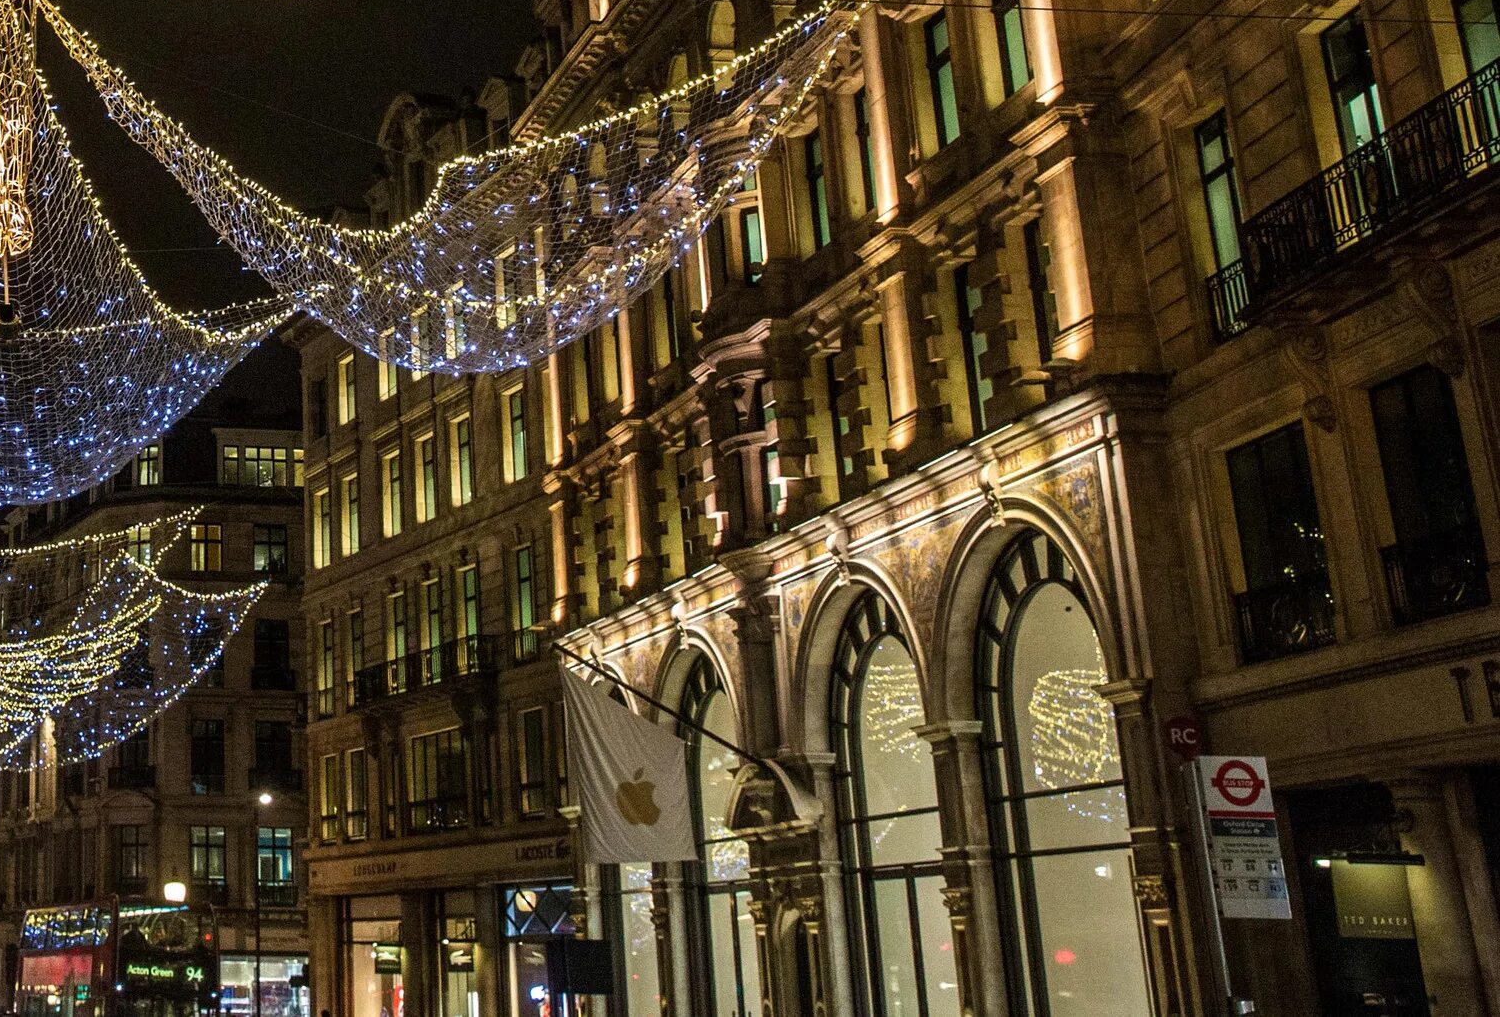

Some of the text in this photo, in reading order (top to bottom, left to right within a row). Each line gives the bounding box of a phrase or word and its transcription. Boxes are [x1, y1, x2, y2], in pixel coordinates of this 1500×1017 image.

[1171, 728, 1197, 744] RC
[1344, 915, 1408, 926] TED BAKER
[127, 964, 204, 982] Acton Green 94
